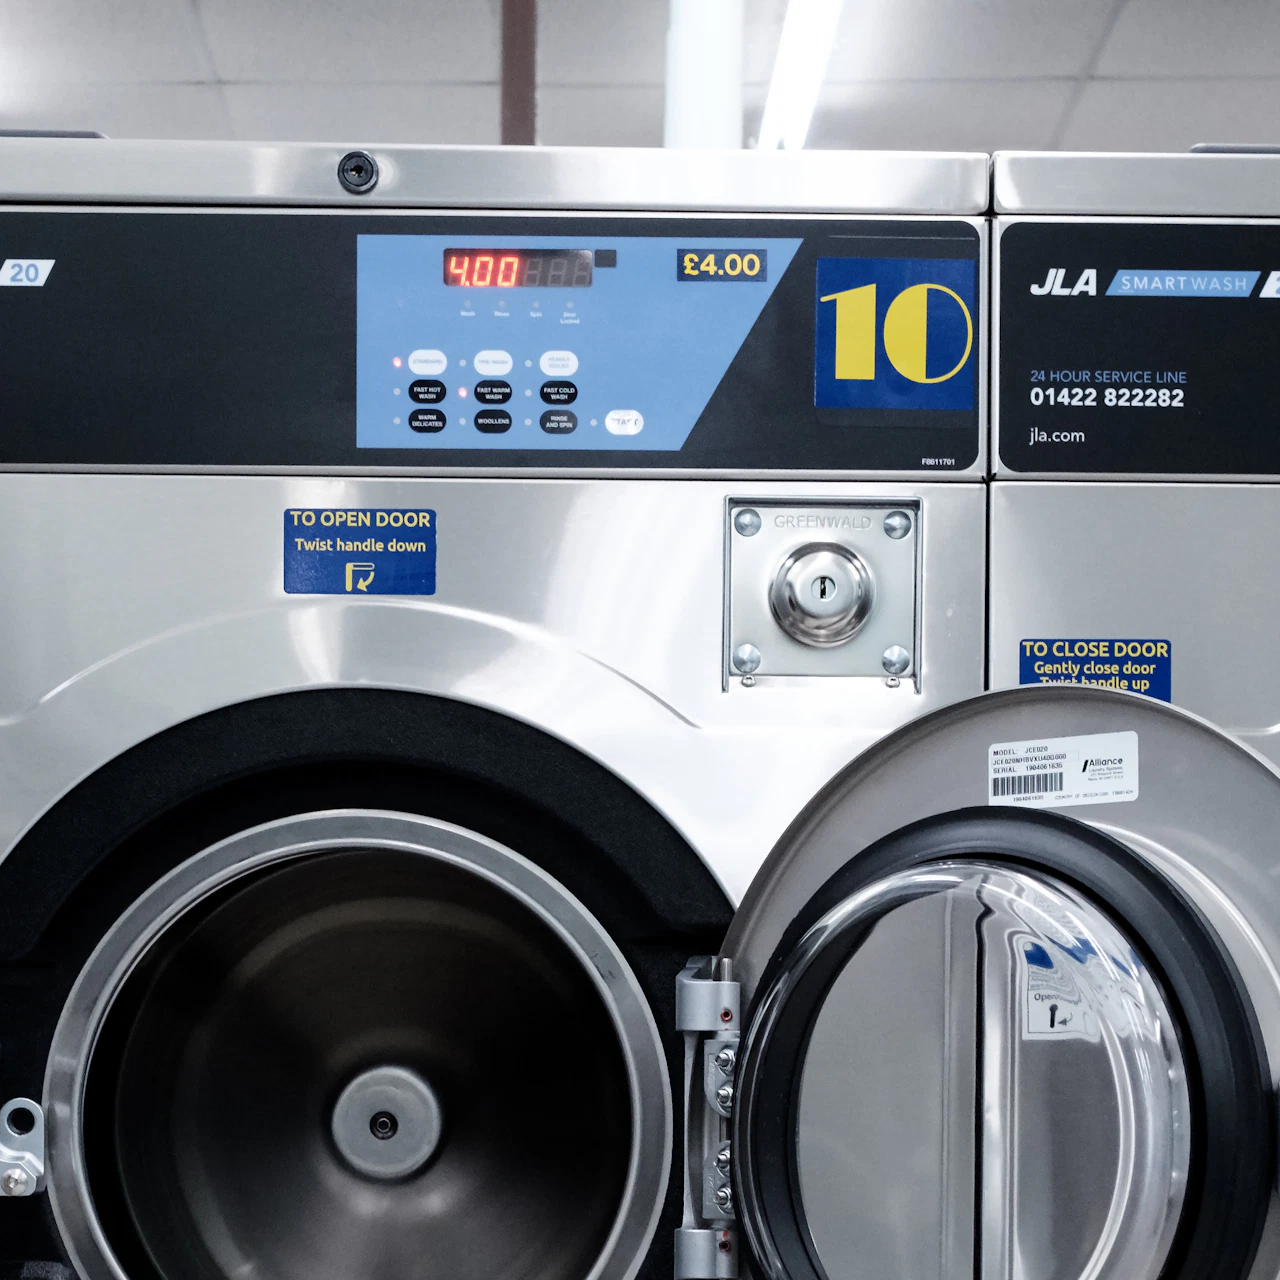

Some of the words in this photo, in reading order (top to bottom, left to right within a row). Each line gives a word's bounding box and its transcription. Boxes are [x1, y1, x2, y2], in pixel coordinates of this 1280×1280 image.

[10, 263, 40, 282] 20
[449, 255, 519, 287] 4.00
[683, 253, 761, 276] £4.00
[1030, 268, 1097, 296] JLA
[819, 283, 973, 384] 10
[1030, 370, 1046, 382] 24
[1050, 370, 1090, 383] HOUR
[1095, 371, 1152, 383] SERVICE
[1156, 371, 1187, 383] LINE
[1030, 387, 1097, 406] 01422
[1104, 388, 1185, 407] 822282
[1029, 427, 1085, 445] jla.com
[290, 511, 316, 526] TO
[320, 511, 371, 527] OPEN
[376, 512, 430, 527] DOOR
[774, 514, 873, 530] GREENWALD
[294, 538, 333, 551] Twist
[336, 538, 384, 552] handle
[387, 538, 426, 552] down
[1022, 641, 1048, 656] TO
[1052, 641, 1110, 657] CLOSE
[1114, 642, 1168, 657] DOOR
[1034, 661, 1080, 676] Gently
[1083, 661, 1119, 674] close
[1122, 661, 1156, 674] door
[1132, 680, 1150, 692] up
[1089, 757, 1123, 766] Alliance
